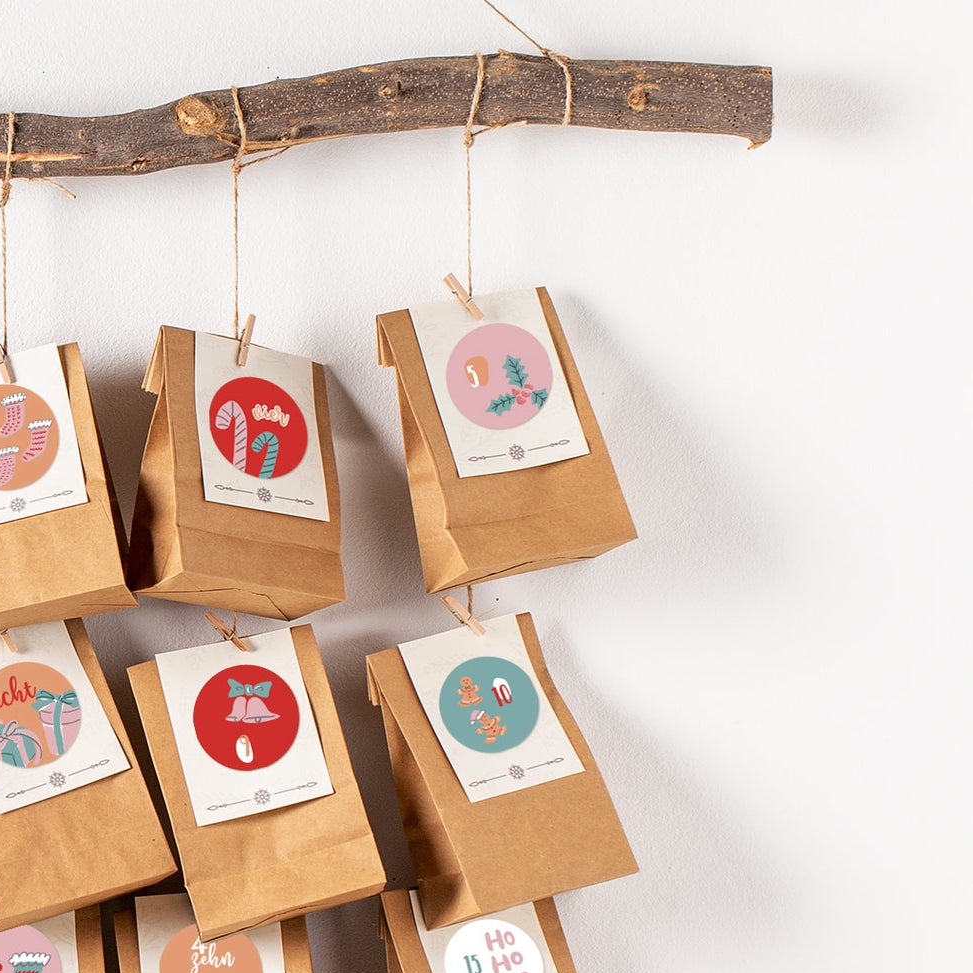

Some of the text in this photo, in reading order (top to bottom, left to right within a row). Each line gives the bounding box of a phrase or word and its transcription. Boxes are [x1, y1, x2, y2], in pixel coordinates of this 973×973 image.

[466, 365, 480, 388] 5
[252, 404, 290, 427] vier
[491, 684, 512, 707] 10
